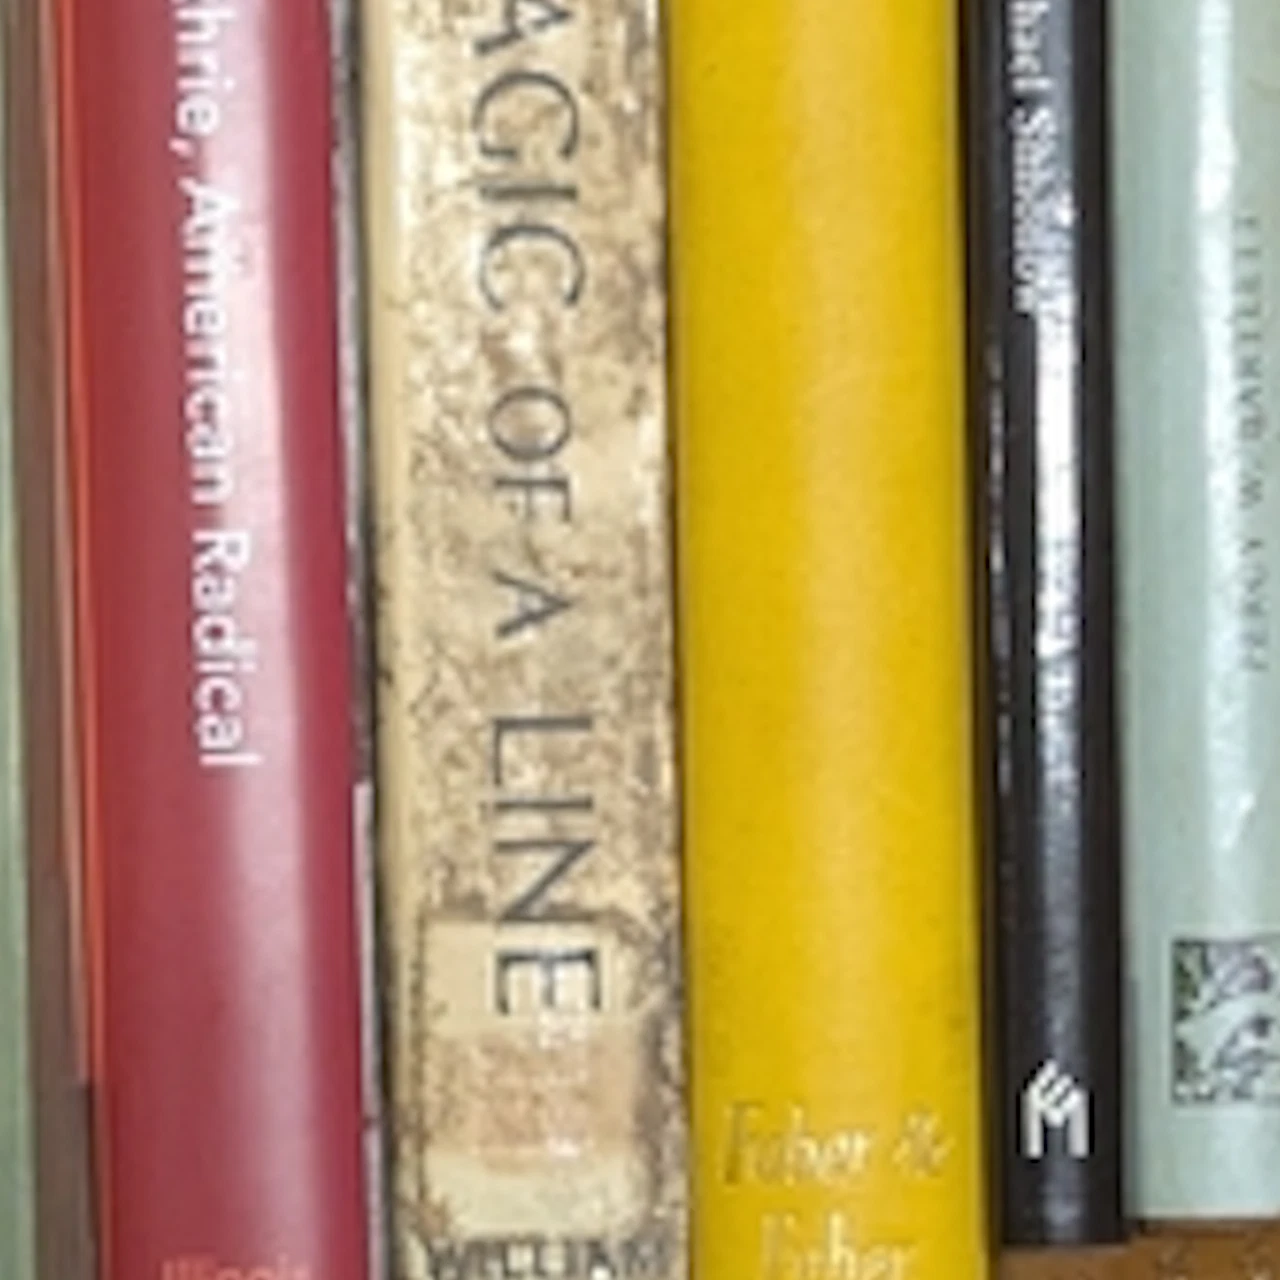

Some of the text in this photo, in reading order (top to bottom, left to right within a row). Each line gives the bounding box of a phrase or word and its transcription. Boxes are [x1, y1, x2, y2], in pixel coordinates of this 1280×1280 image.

[179, 167, 243, 504] American
[488, 385, 573, 524] OF
[191, 529, 263, 767] Radical
[492, 568, 575, 640] A
[485, 714, 602, 1015] LINE
